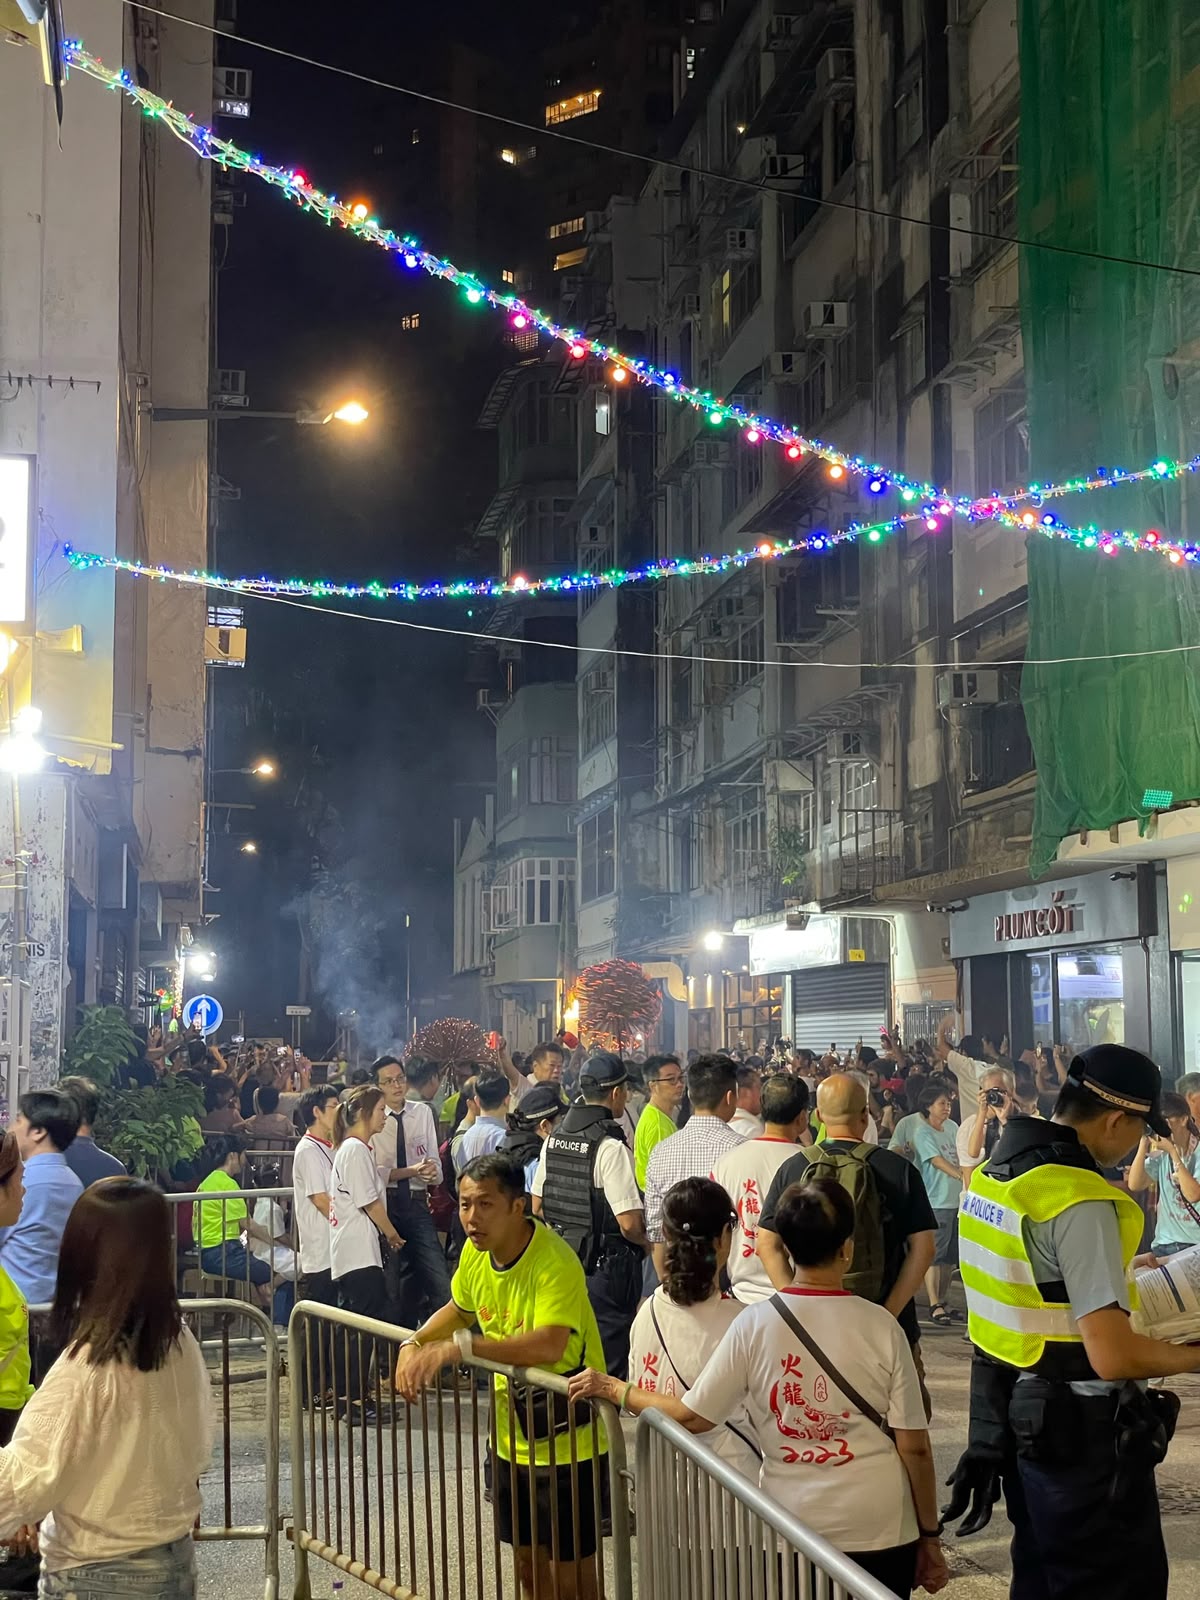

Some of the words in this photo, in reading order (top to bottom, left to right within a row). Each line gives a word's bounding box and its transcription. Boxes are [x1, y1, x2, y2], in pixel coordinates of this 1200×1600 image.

[555, 1139, 580, 1151] POLICE
[970, 1196, 995, 1223] POLICE
[781, 1353, 805, 1406] 火龍
[779, 1438, 855, 1467] 2023
